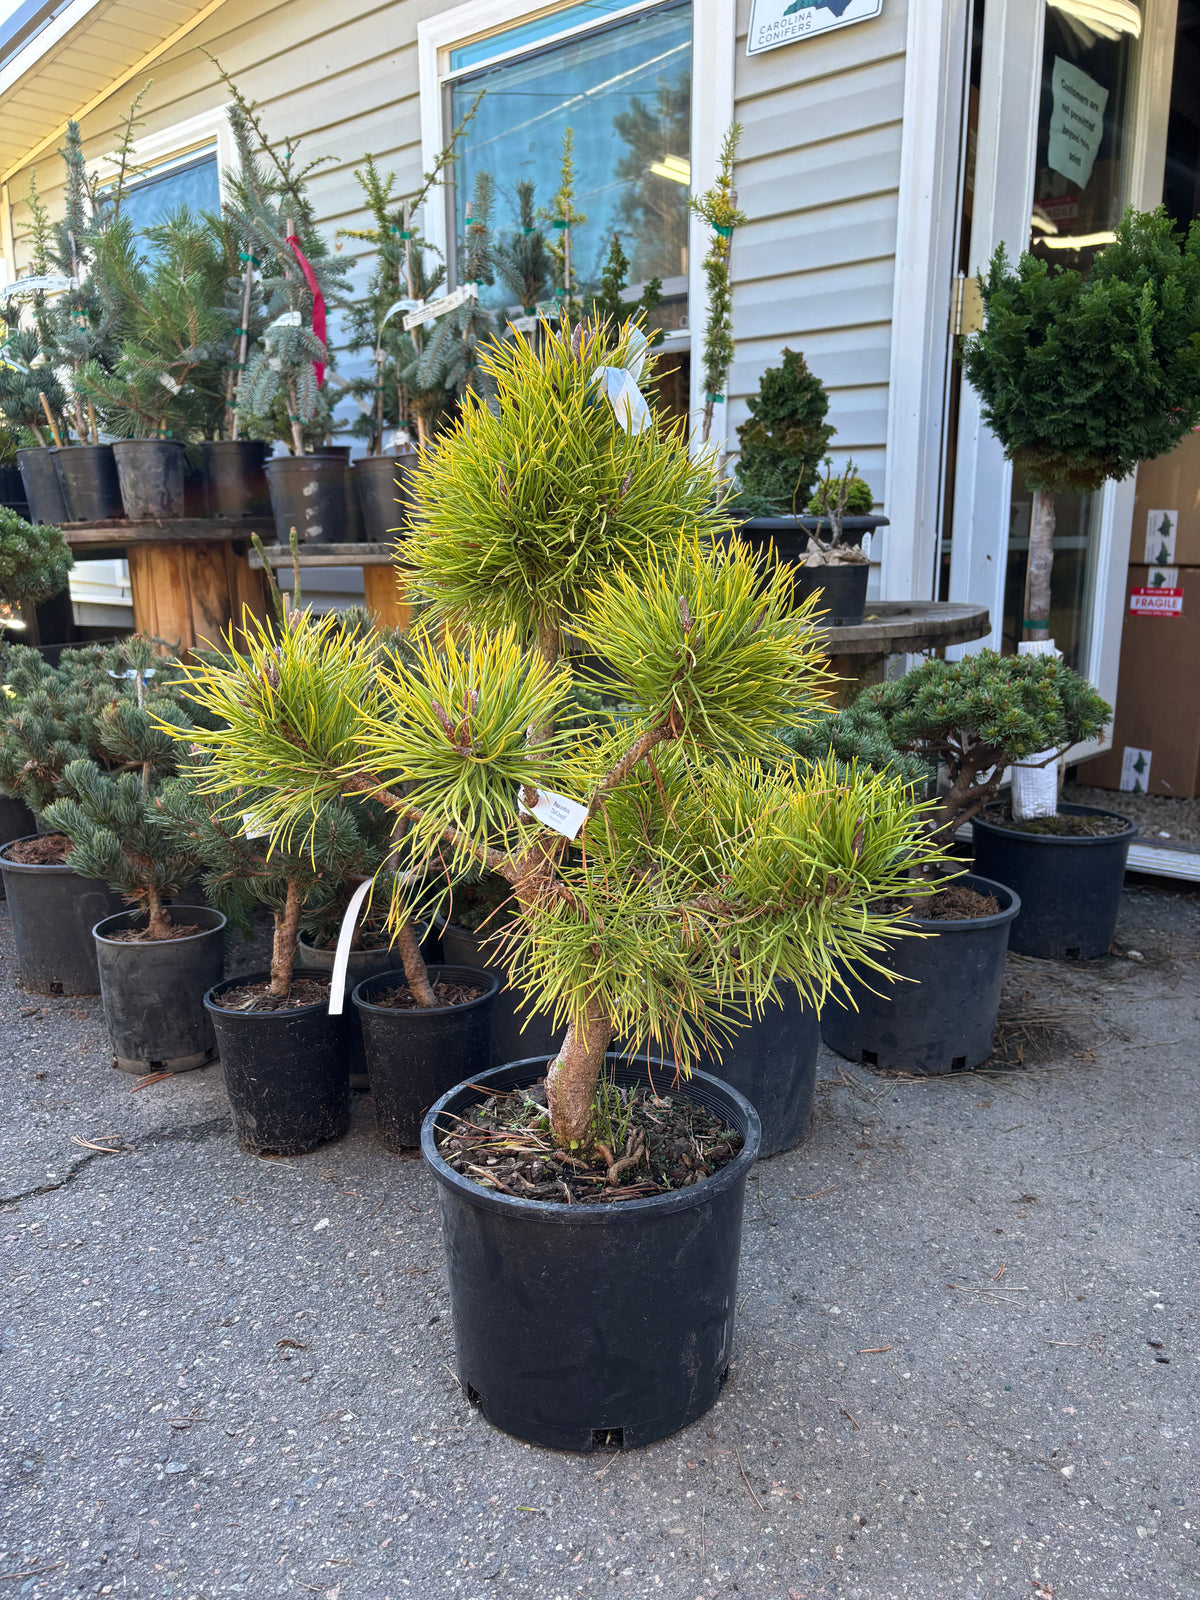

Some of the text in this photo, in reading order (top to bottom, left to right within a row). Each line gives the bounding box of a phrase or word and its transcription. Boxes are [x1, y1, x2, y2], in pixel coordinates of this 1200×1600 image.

[758, 21, 812, 45] CONIFERS
[760, 11, 813, 35] CAROLINA
[1061, 79, 1099, 112] Customers are
[1135, 597, 1178, 609] FRAGILE
